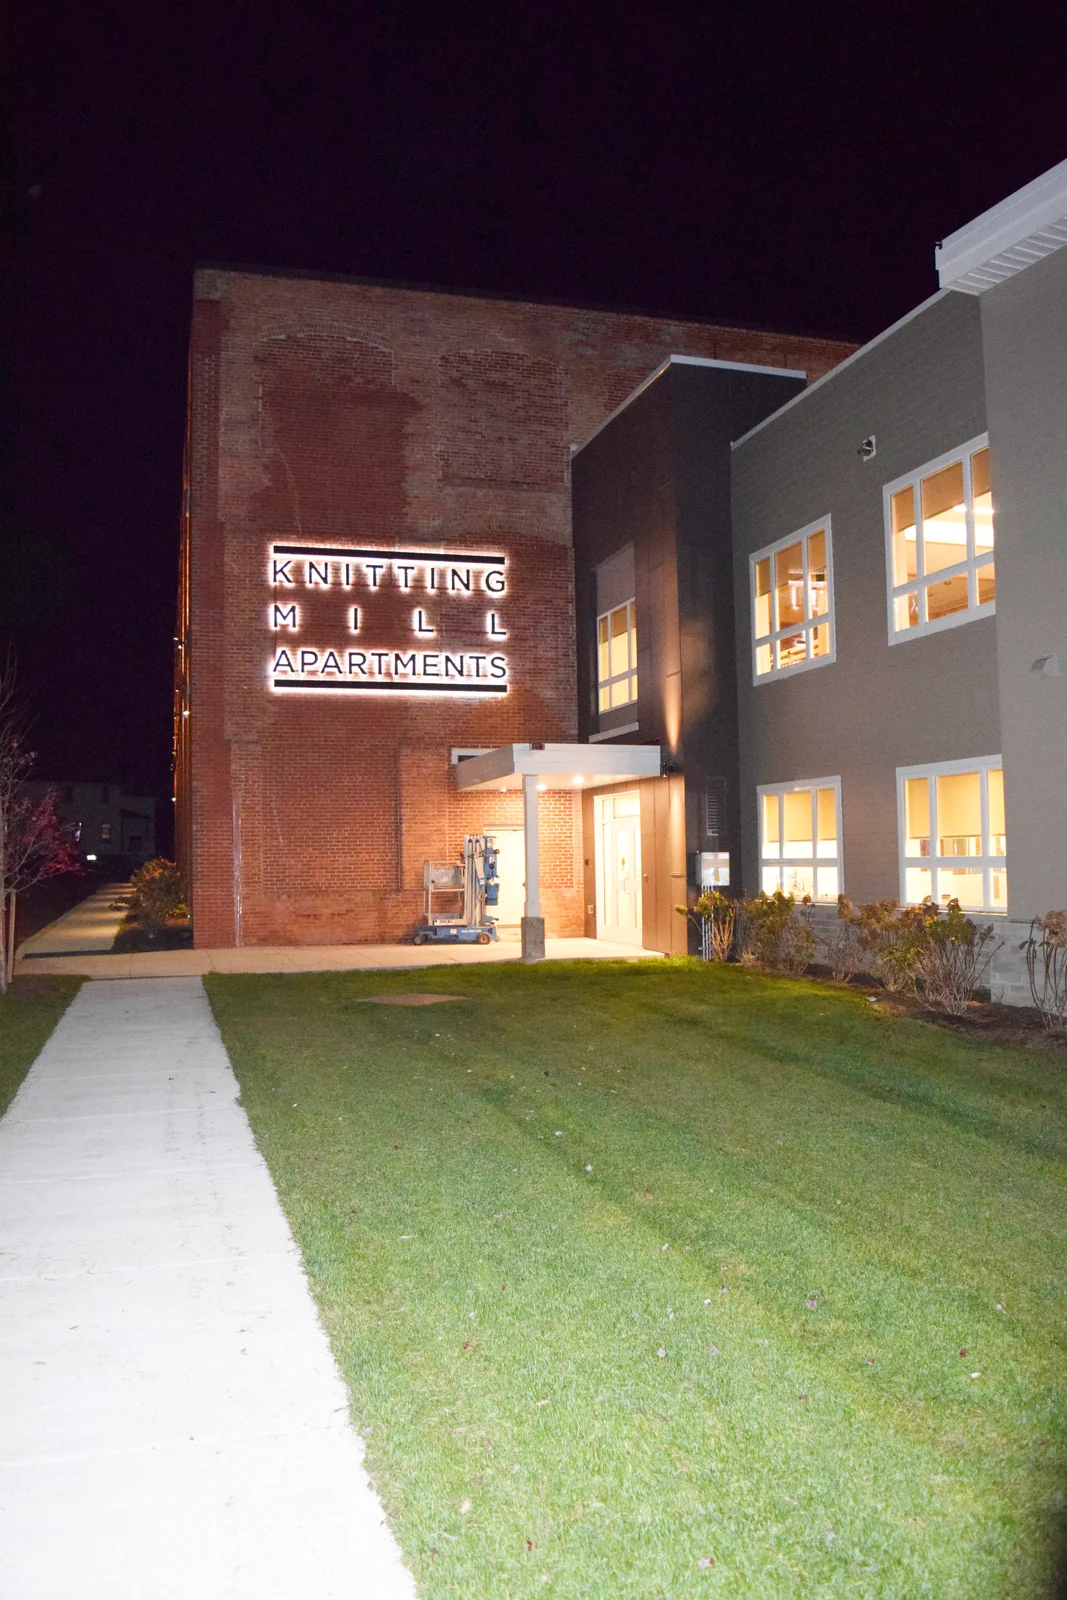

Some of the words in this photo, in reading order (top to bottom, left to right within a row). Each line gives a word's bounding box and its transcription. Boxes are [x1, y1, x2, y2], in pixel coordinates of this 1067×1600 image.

[273, 560, 506, 592] KNITTING
[273, 604, 507, 635] MILL
[273, 650, 507, 679] APARTMENTS
